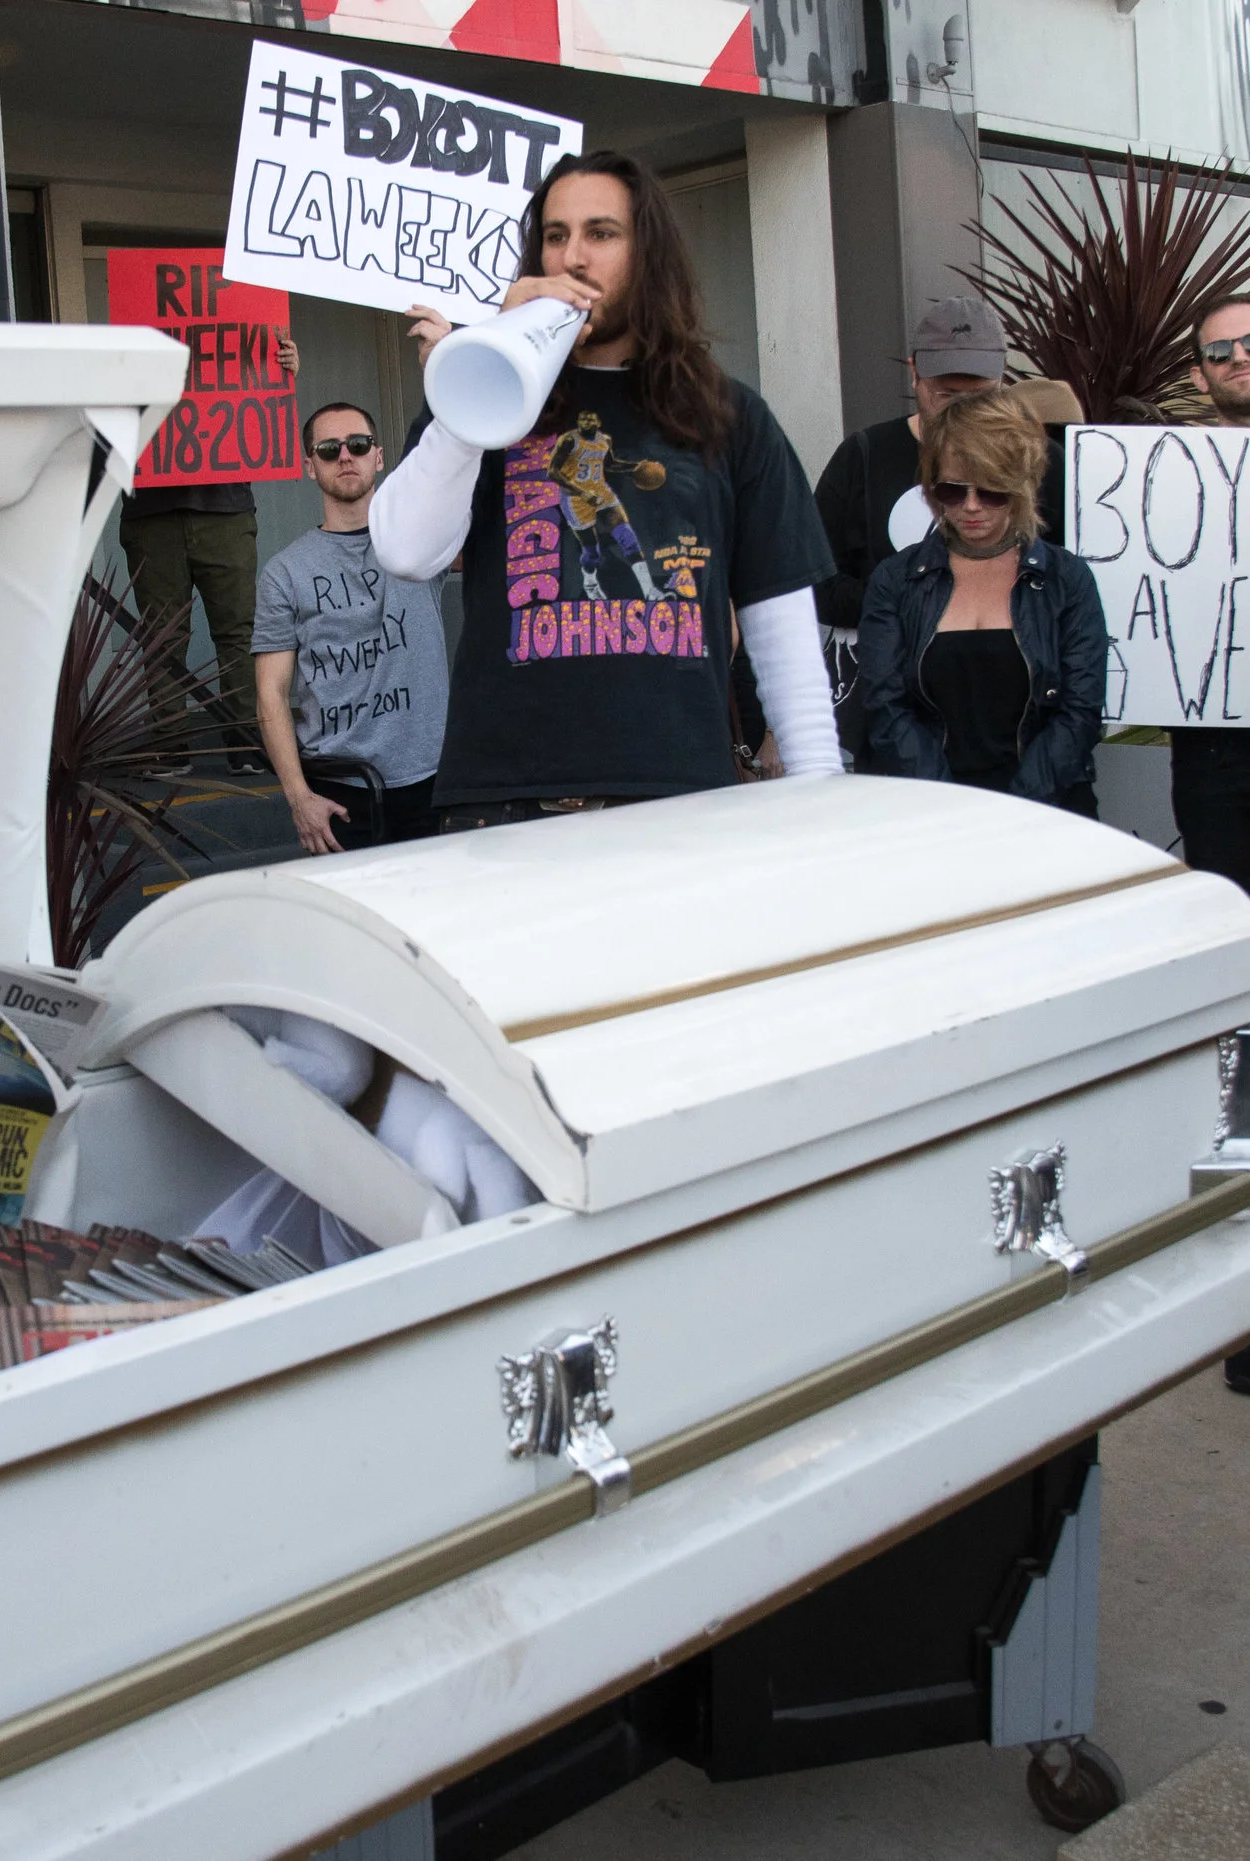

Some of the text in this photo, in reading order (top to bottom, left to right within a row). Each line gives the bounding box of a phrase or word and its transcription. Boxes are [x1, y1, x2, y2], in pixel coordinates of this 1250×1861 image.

[155, 264, 234, 317] RIP
[505, 432, 562, 609] MAGIC
[1073, 428, 1250, 573] BOY
[510, 600, 704, 661] JOHNSON
